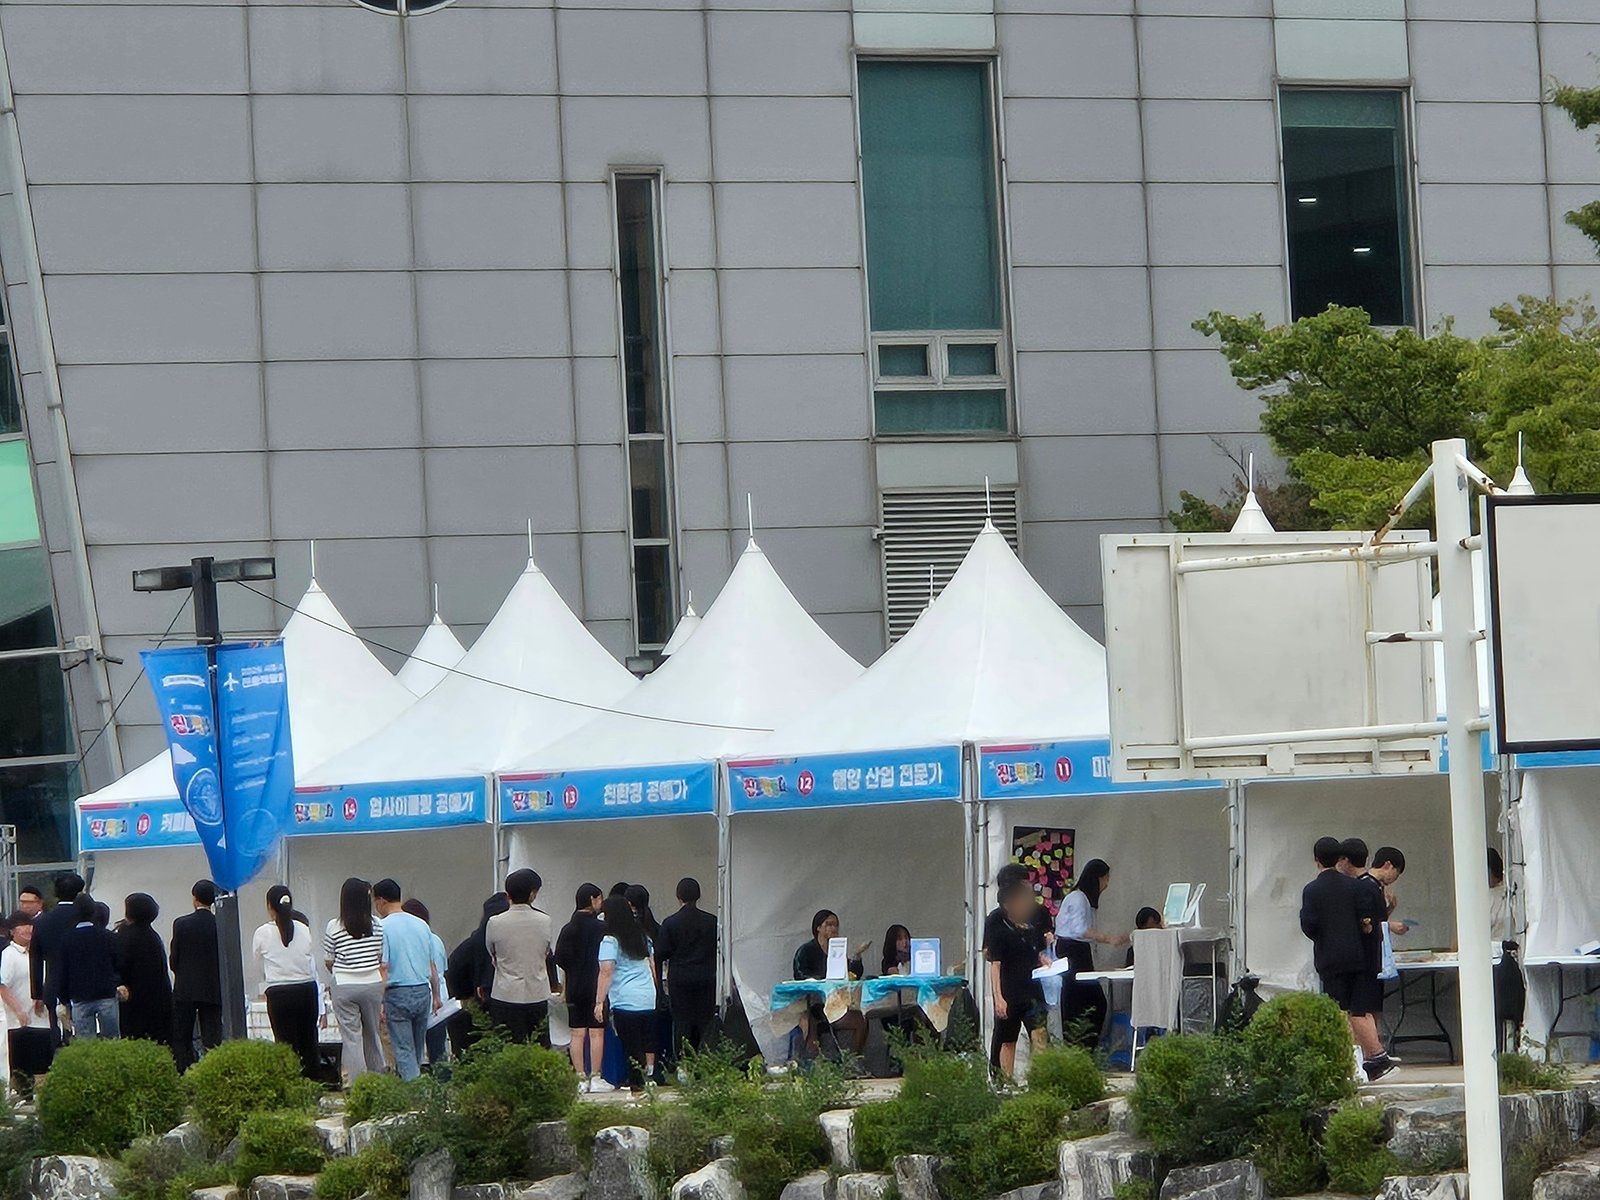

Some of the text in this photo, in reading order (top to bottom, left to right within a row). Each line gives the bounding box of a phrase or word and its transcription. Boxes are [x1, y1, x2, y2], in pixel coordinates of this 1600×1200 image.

[799, 777, 812, 790] 12
[833, 768, 861, 790] 해양
[866, 766, 894, 789] 산업
[900, 762, 942, 786] 전문가
[1058, 763, 1070, 777] 11
[1092, 756, 1110, 777] 미
[565, 791, 576, 804] 13
[604, 782, 643, 805] 친환경
[646, 779, 688, 802] 공예가
[344, 802, 356, 815] 14
